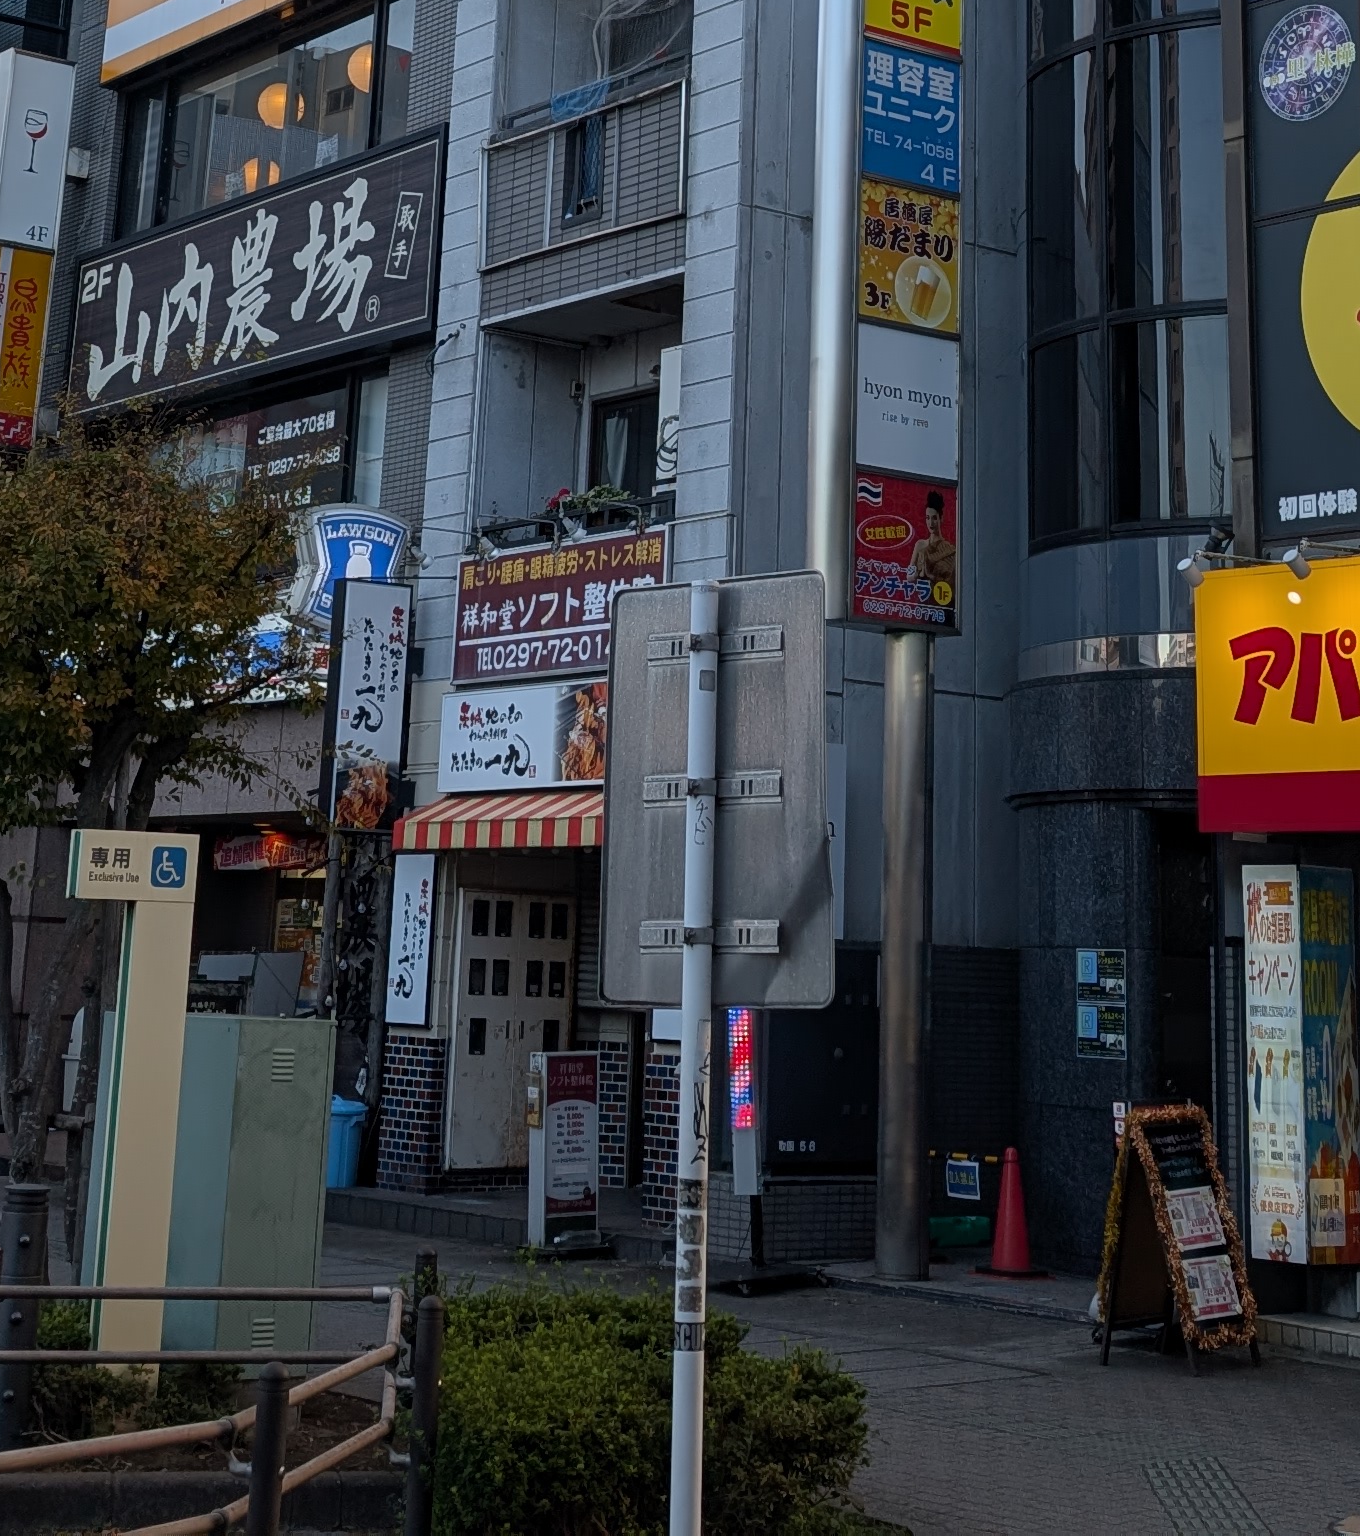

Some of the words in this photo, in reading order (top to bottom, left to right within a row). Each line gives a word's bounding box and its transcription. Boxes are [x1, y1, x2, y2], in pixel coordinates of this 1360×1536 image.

[890, 0, 934, 33] 5F
[867, 48, 956, 105] 理容室
[864, 88, 956, 135] ユニーク
[865, 126, 891, 147] TEL
[893, 134, 955, 162] 74-1058
[920, 164, 958, 187] 4F
[25, 225, 50, 245] 4F
[391, 203, 416, 267] 取手
[863, 216, 955, 263] 陽だまり
[82, 269, 113, 305] 2F
[89, 178, 375, 401] 山内農場
[864, 281, 892, 311] 3F
[863, 377, 904, 402] hyon
[907, 386, 953, 410] myon
[1278, 487, 1359, 523] 初回体験
[325, 523, 398, 548] LAWSON
[854, 570, 933, 602] アンチャラ
[89, 847, 131, 869] 専用
[89, 871, 124, 883] Exclusive
